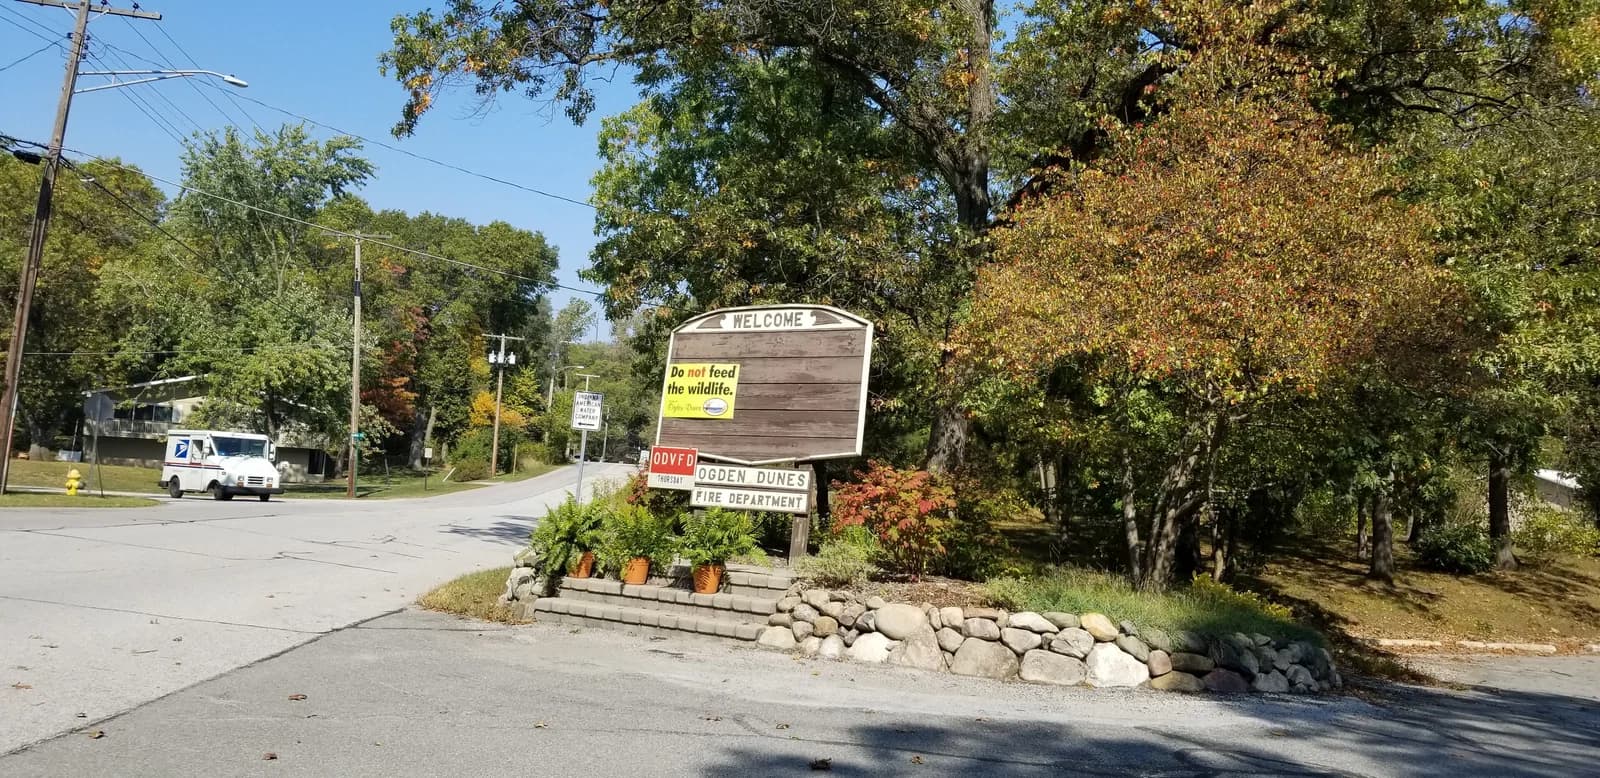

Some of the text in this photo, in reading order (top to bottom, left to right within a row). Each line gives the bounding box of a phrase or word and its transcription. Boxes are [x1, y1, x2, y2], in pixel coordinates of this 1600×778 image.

[733, 311, 804, 329] WELCOME
[670, 365, 736, 378] Do not feed
[667, 382, 733, 396] the wildlife.
[653, 452, 694, 467] ODVFD
[657, 475, 683, 484] THURSDAY
[698, 467, 806, 487] OGDEN DUNES
[695, 491, 803, 508] FIRE DEPARTMENT
